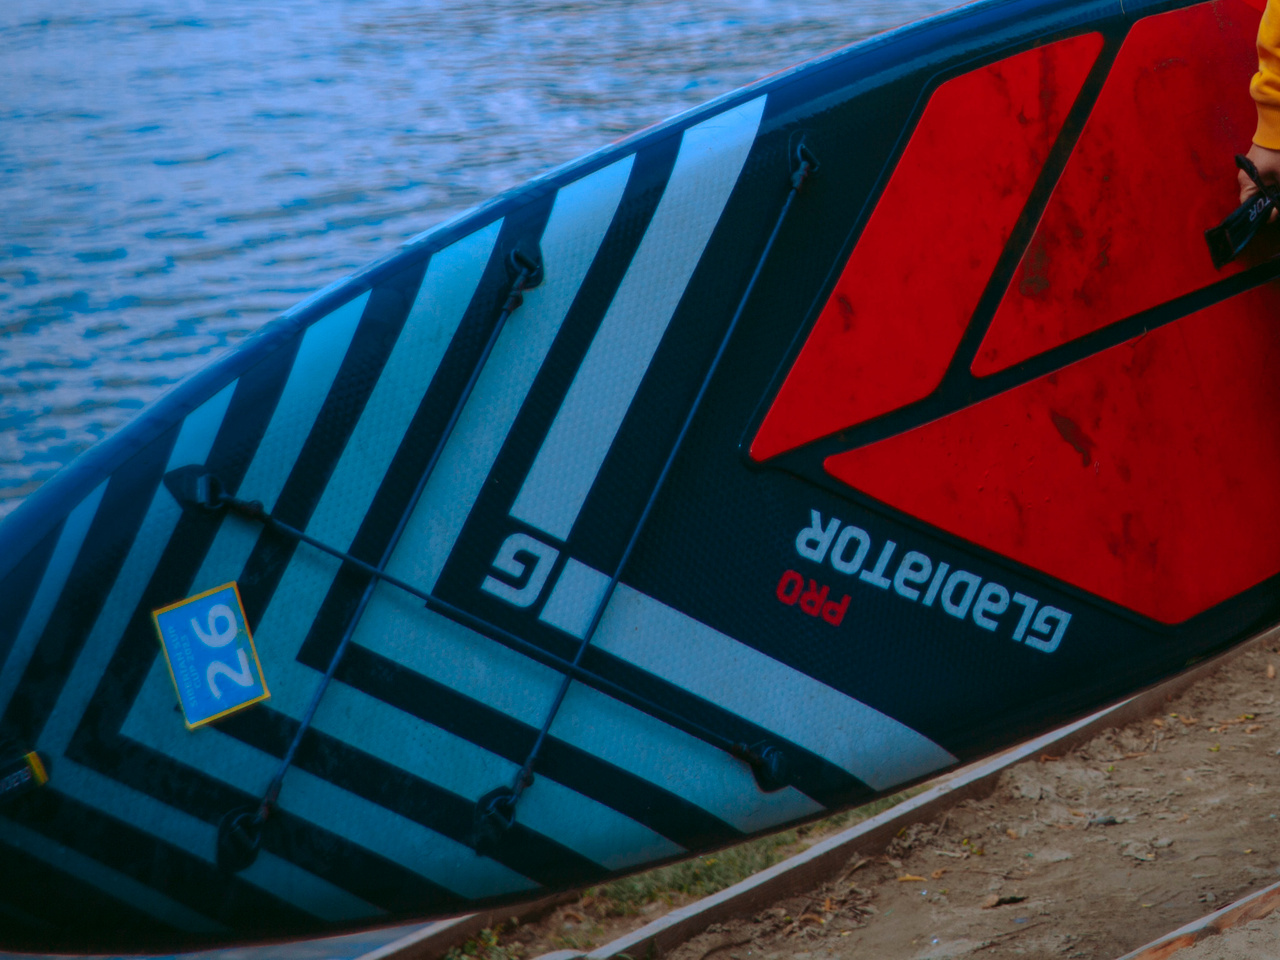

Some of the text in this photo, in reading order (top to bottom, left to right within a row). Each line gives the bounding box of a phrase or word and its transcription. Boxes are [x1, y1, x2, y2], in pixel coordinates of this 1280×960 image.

[480, 532, 560, 609] G
[775, 568, 852, 627] PRO
[190, 603, 254, 700] 26
